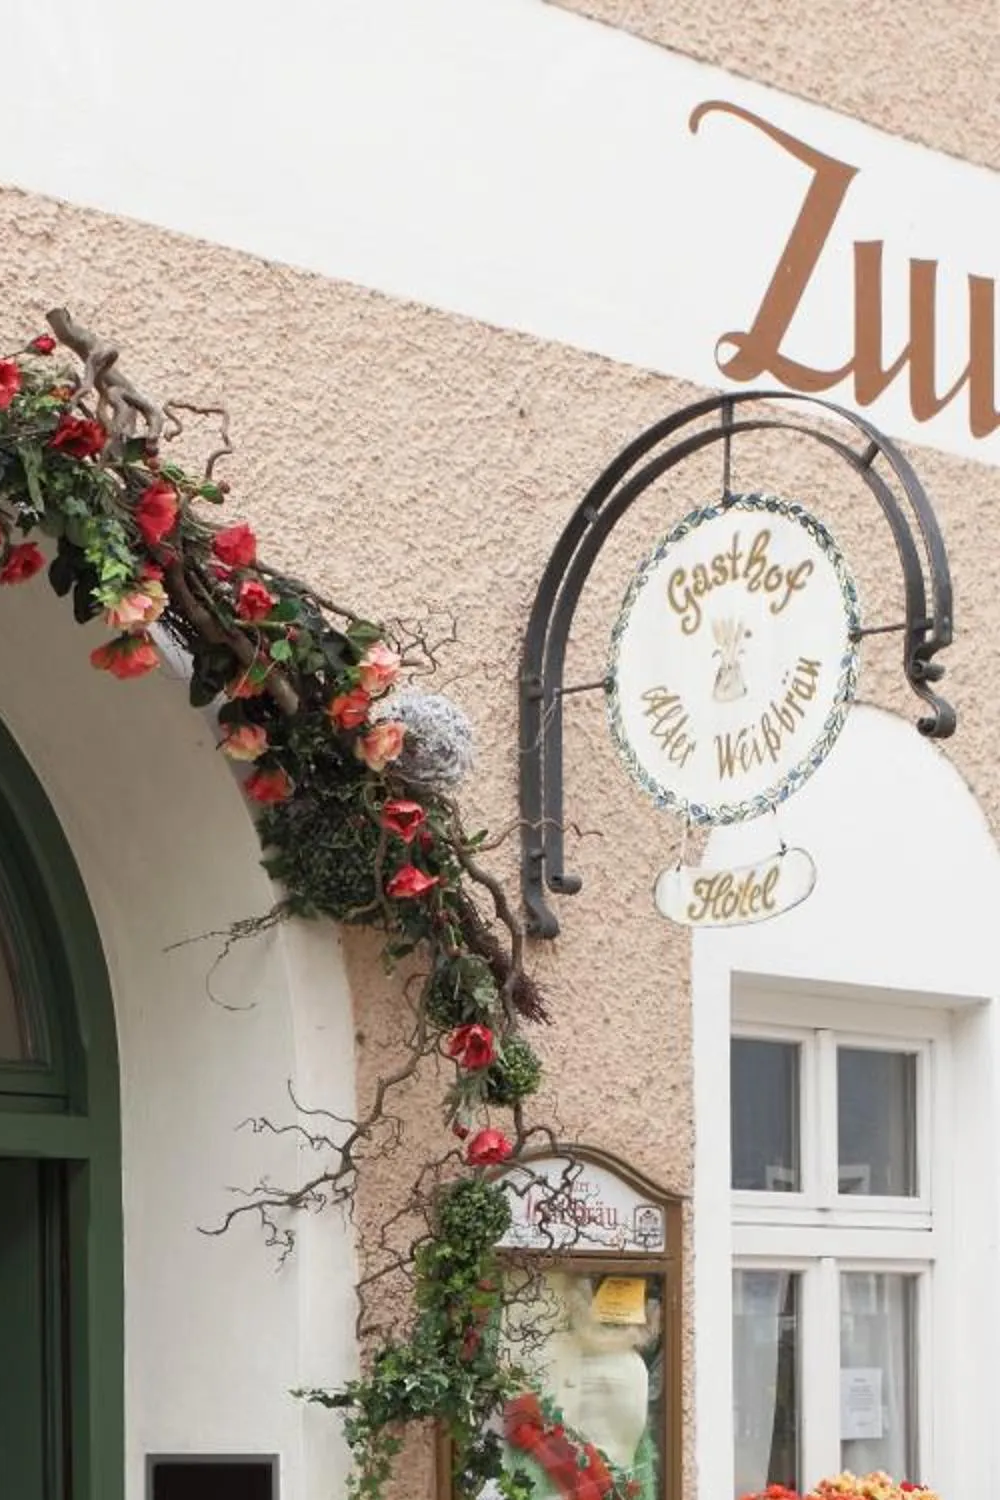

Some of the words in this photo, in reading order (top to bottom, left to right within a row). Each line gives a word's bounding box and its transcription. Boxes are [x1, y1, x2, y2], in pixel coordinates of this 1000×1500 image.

[667, 528, 814, 636] Gasthof
[640, 685, 697, 769] Alter
[714, 655, 822, 782] Weißbräu
[687, 865, 780, 921] Hotel
